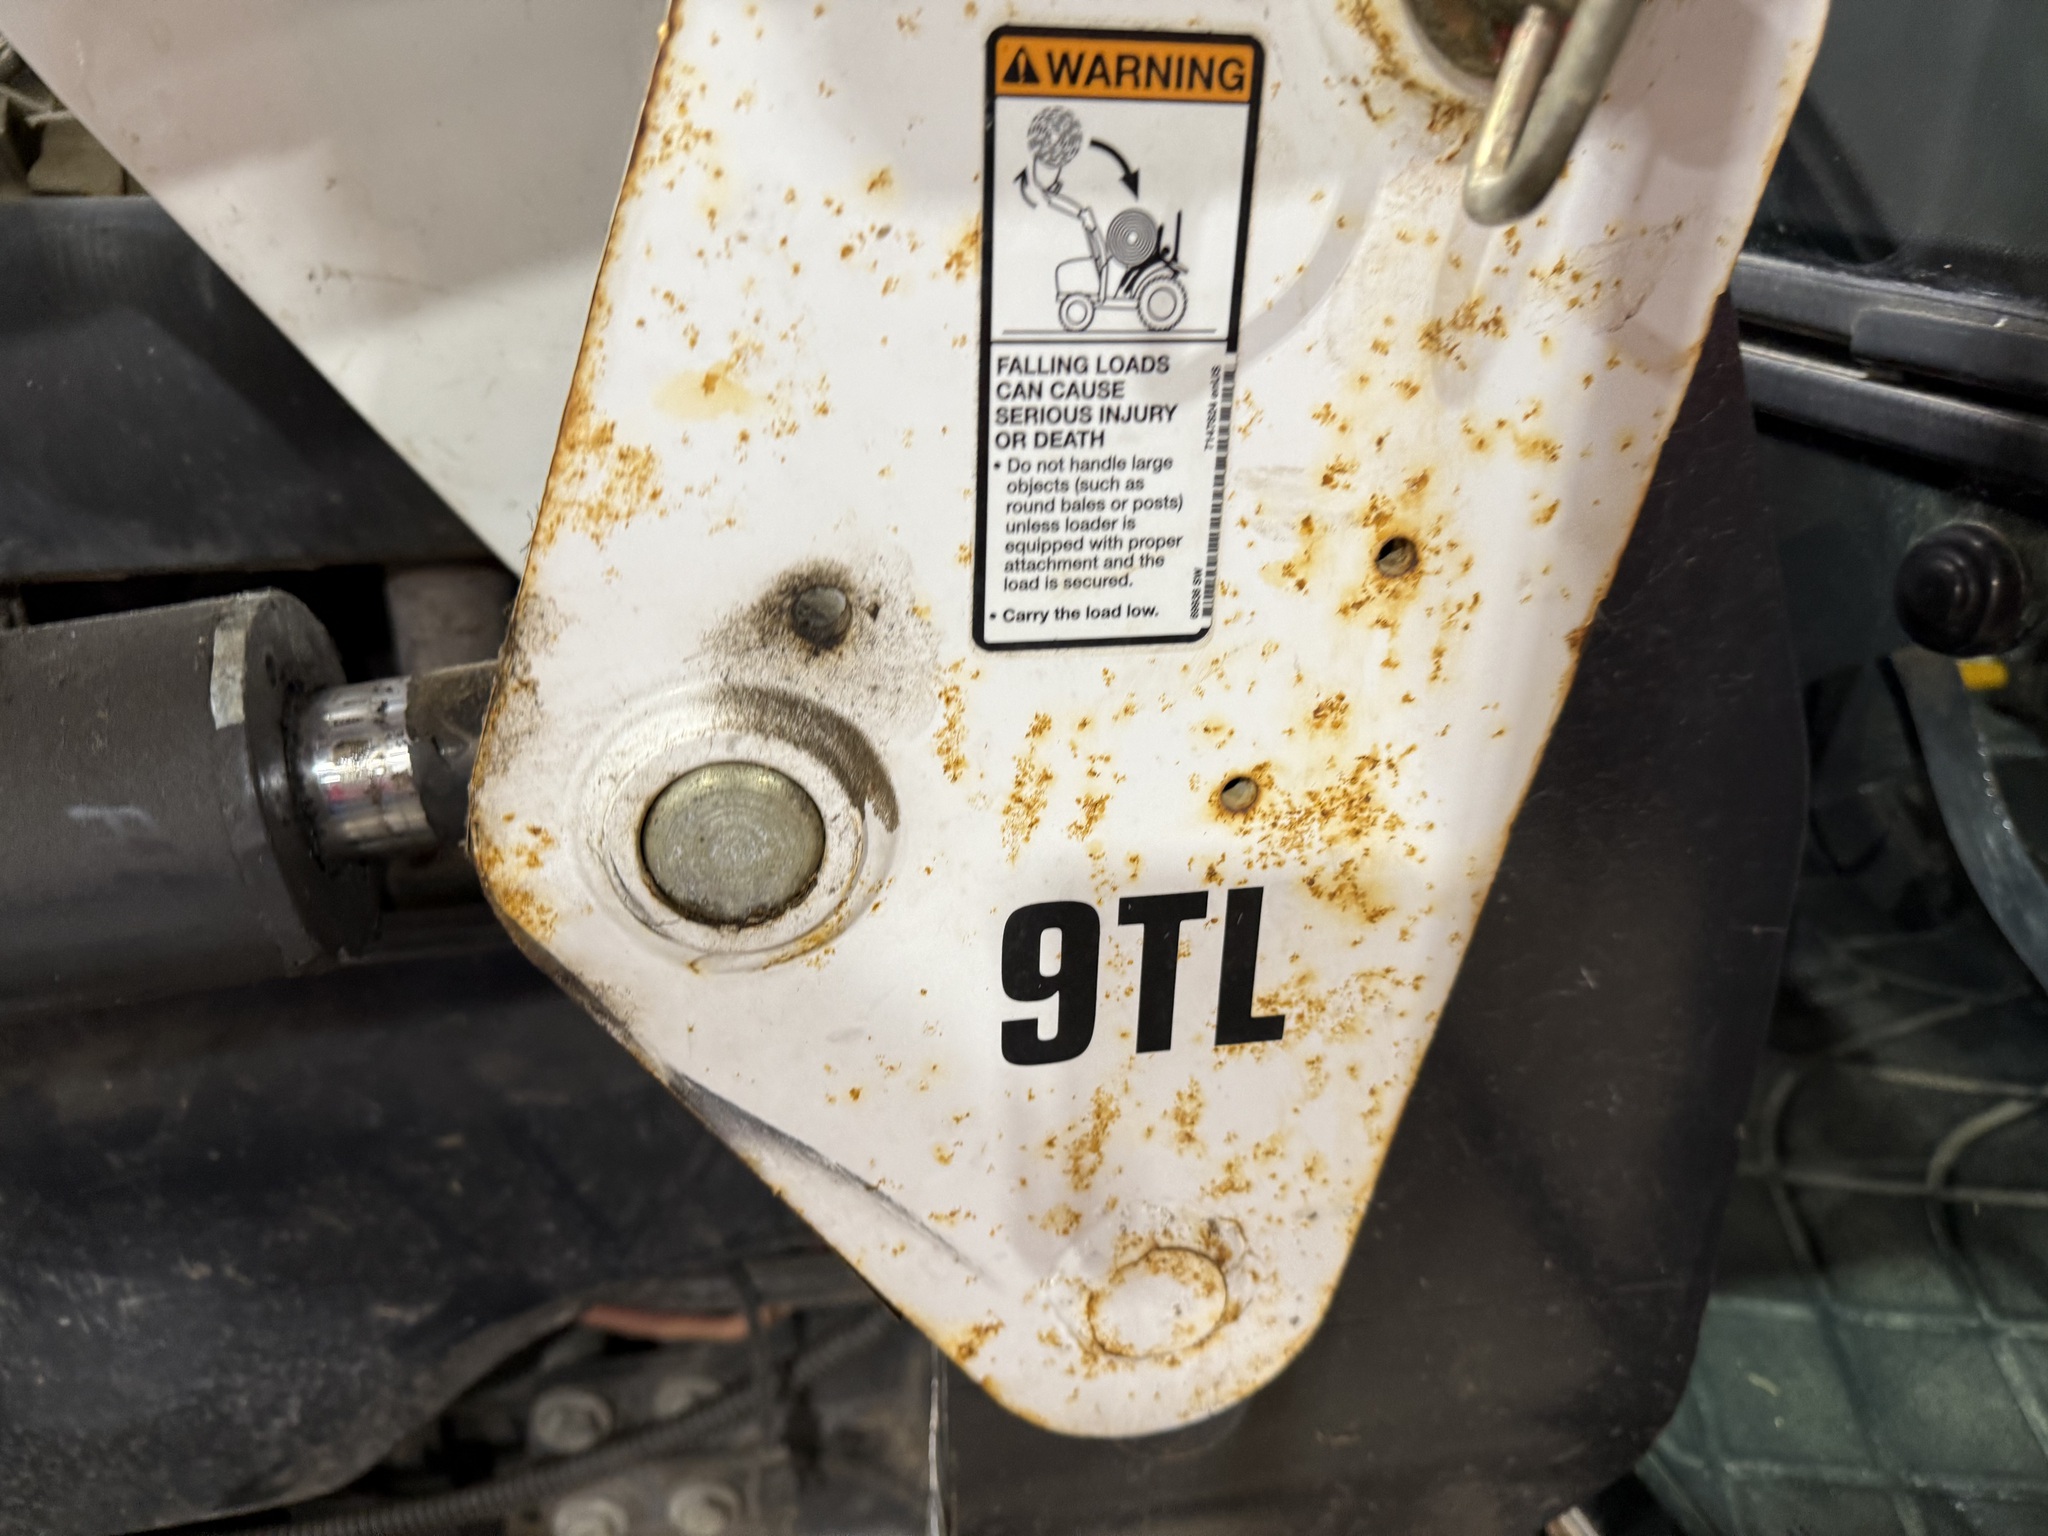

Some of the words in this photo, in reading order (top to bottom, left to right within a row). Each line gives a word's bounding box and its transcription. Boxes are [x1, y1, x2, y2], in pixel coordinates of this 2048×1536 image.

[1047, 52, 1245, 92] WARNING
[997, 356, 1088, 375] FALLING
[1096, 354, 1170, 375] LOADS
[996, 381, 1042, 400] CAN
[1050, 381, 1124, 400] CAUSE
[996, 406, 1092, 425] SERIOUS
[1100, 404, 1178, 423] INJURY
[995, 432, 1026, 449] OR
[1034, 430, 1104, 448] DEATH
[1008, 458, 1031, 473] Do
[1037, 458, 1063, 472] not
[1070, 456, 1126, 471] handle
[1132, 455, 1173, 473] large
[1007, 478, 1069, 496] objects
[1075, 476, 1119, 495] (such
[1126, 479, 1144, 490] as
[1007, 498, 1055, 513] round
[1061, 497, 1105, 512] bales
[1111, 499, 1128, 511] or
[1133, 494, 1183, 513] posts)
[1006, 518, 1059, 533] unless
[1066, 517, 1118, 531] loader
[1123, 516, 1135, 530] is
[1005, 536, 1083, 556] equipped
[1090, 536, 1123, 550] with
[1128, 537, 1183, 556] proper
[1005, 556, 1098, 572] attachment
[1104, 554, 1134, 569] and
[1140, 553, 1164, 568] the
[1004, 576, 1039, 591] load
[1045, 576, 1058, 590] is
[1064, 573, 1132, 589] secured.
[1003, 609, 1049, 624] Carry
[1055, 607, 1080, 620] the
[1086, 604, 1121, 619] load
[1127, 604, 1158, 617] low.
[1001, 886, 1286, 1066] 9TL
